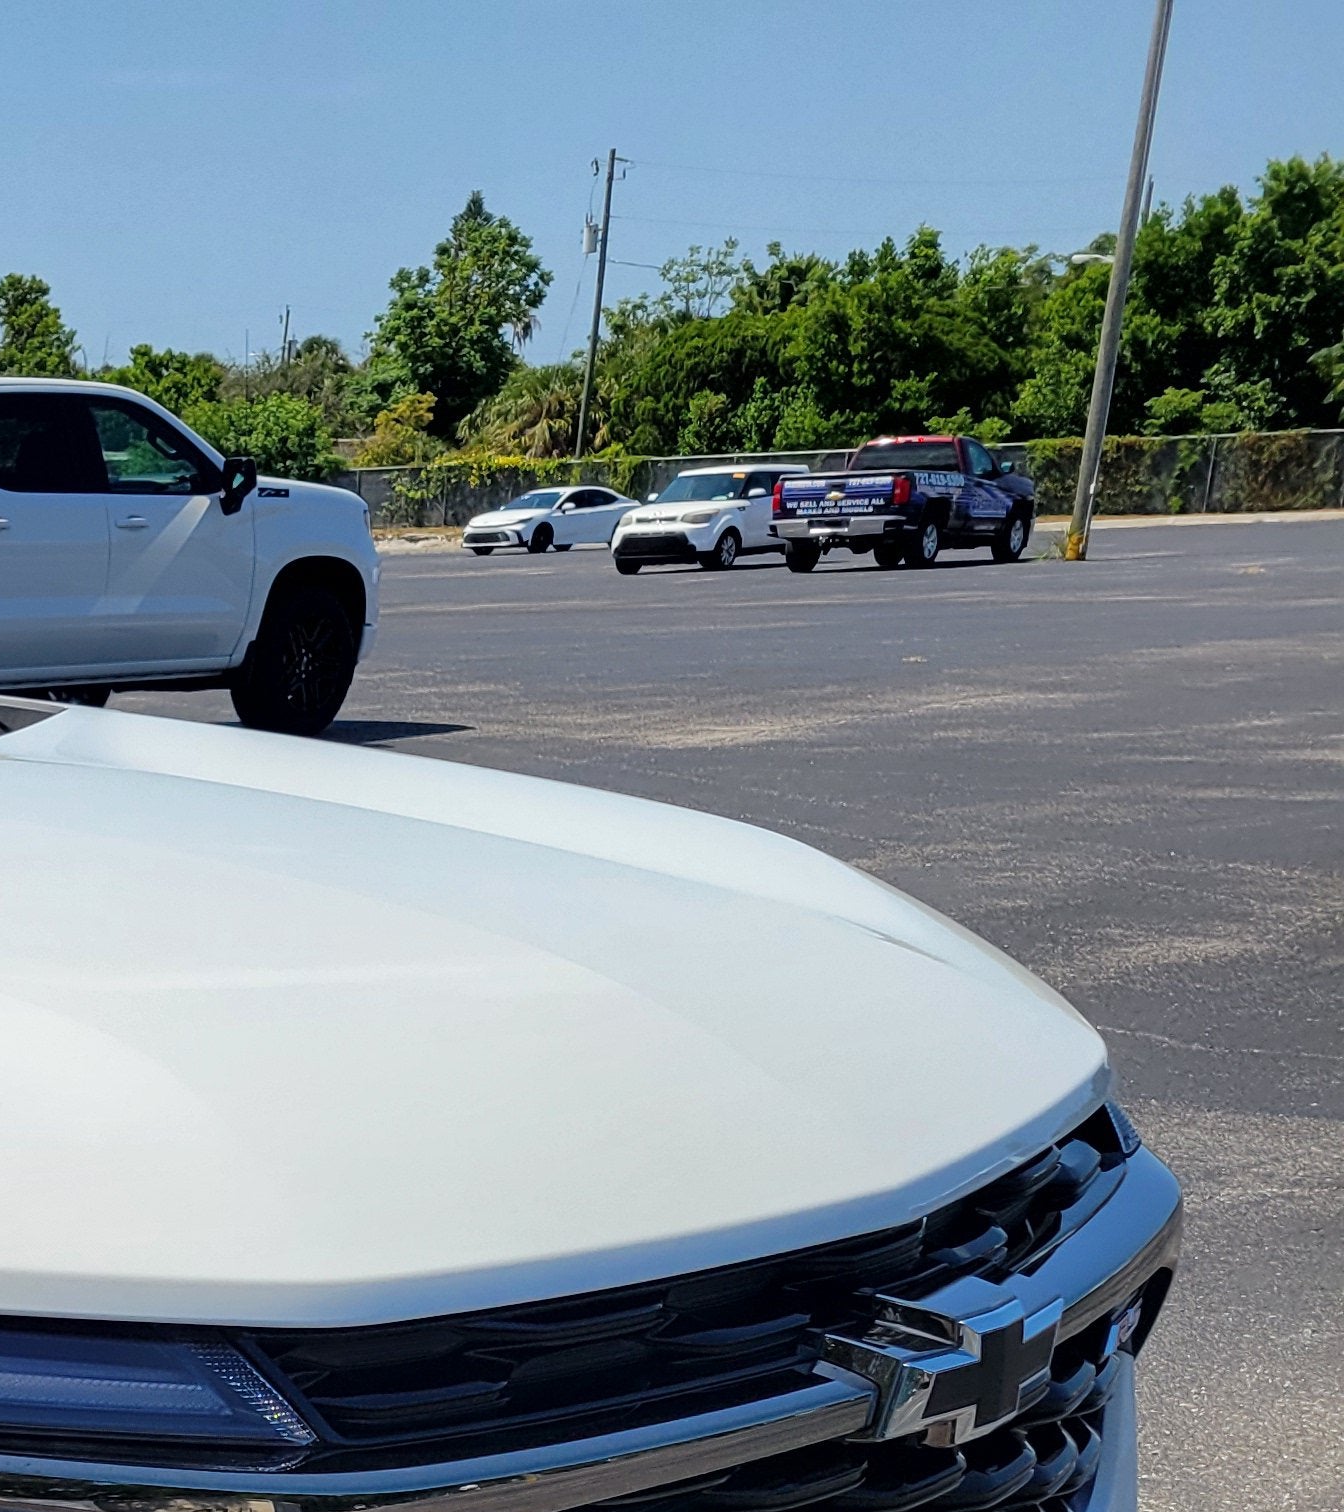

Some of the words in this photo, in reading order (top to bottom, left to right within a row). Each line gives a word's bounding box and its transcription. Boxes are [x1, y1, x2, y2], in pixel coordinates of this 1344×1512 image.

[799, 500, 817, 509] SELL
[818, 499, 835, 507] AND
[837, 498, 870, 507] SERVICE
